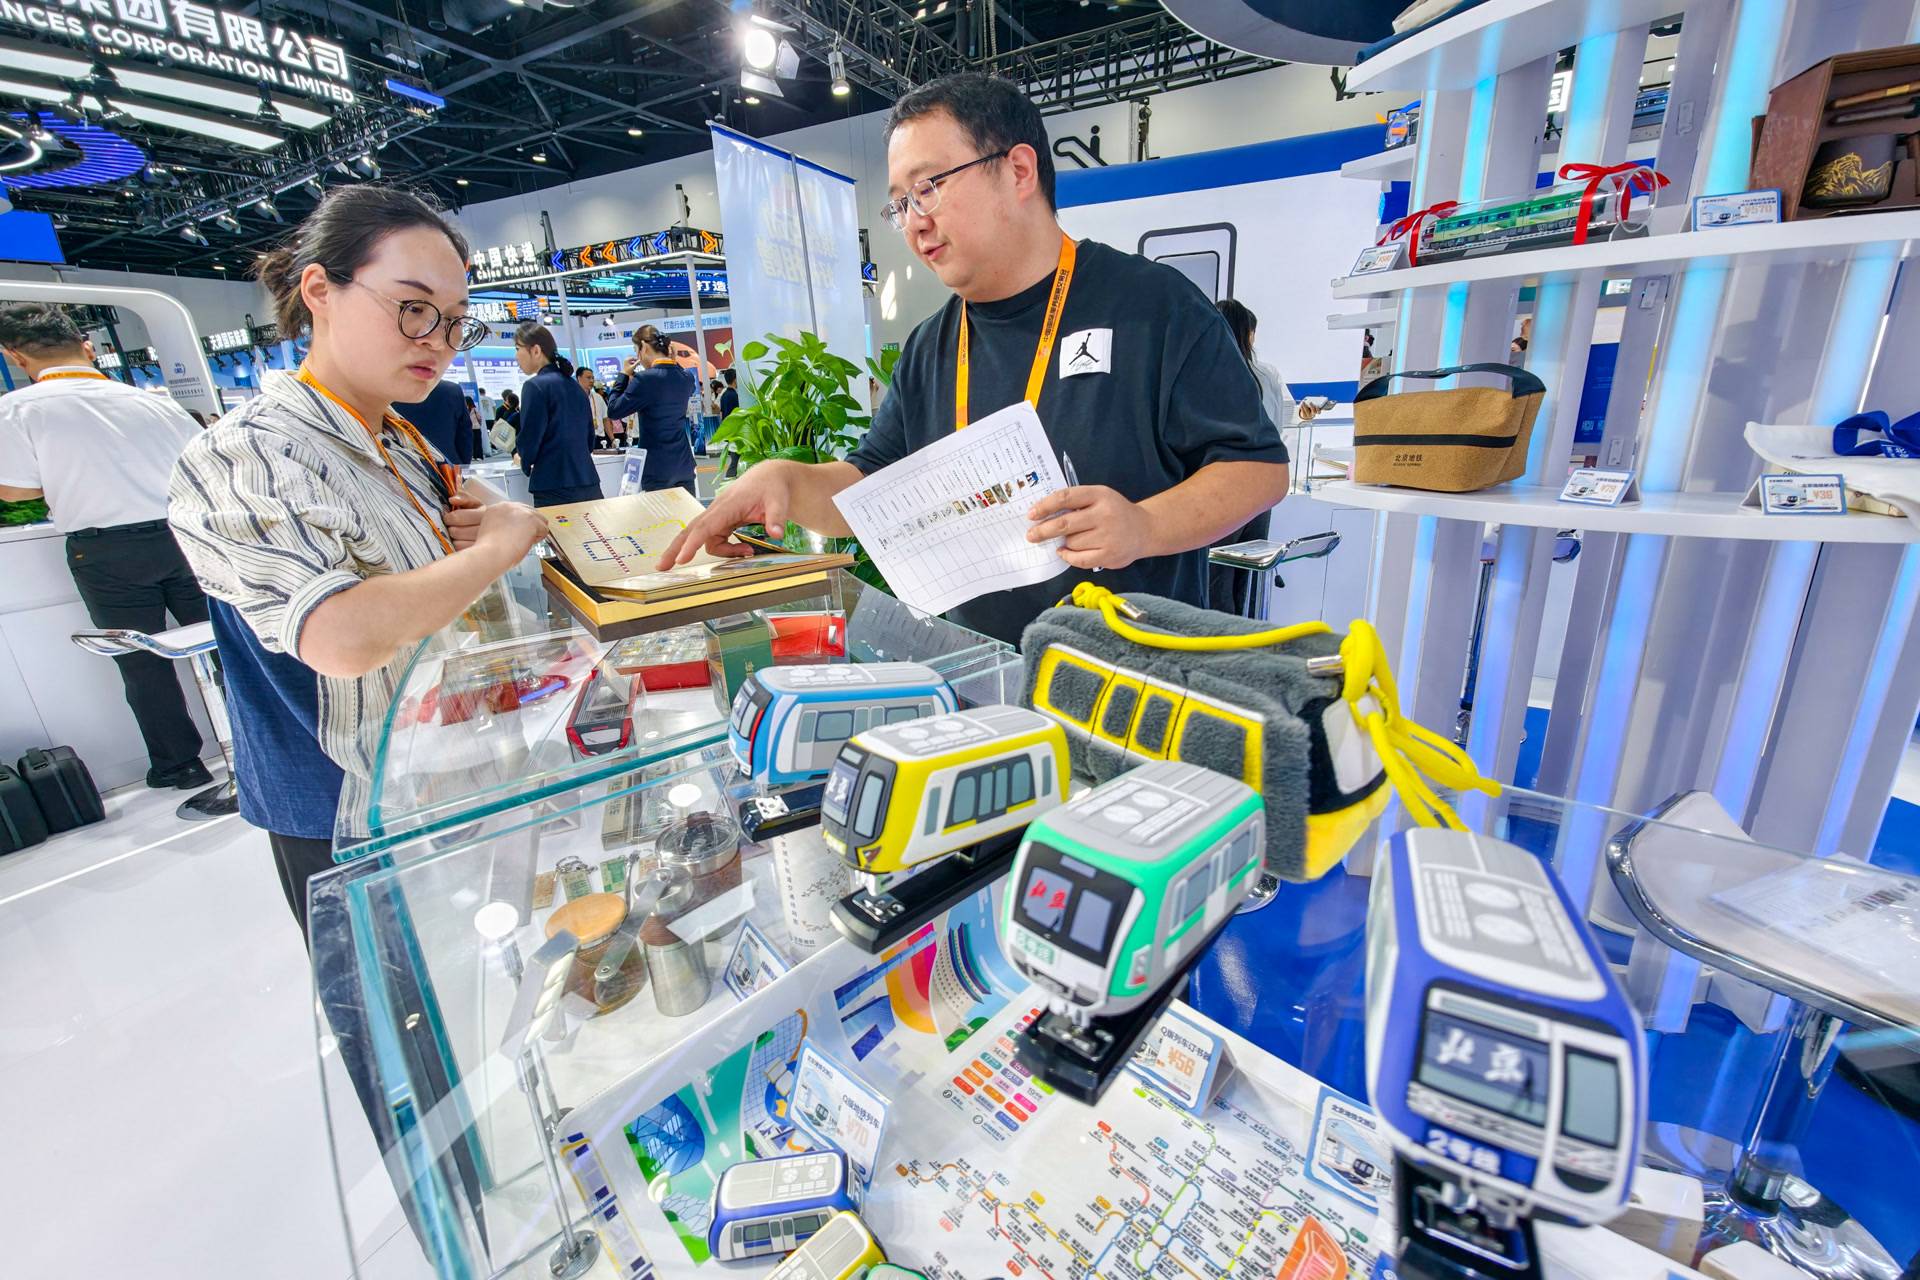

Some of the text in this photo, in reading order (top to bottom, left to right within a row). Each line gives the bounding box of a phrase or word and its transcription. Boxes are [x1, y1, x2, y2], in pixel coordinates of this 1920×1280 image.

[0, 1, 354, 103] NCES CORPORATION LIMITED
[474, 241, 538, 270] 中国快递
[477, 263, 539, 280] China Express
[1167, 1046, 1196, 1078] ¥56
[1436, 1028, 1526, 1083] 北京
